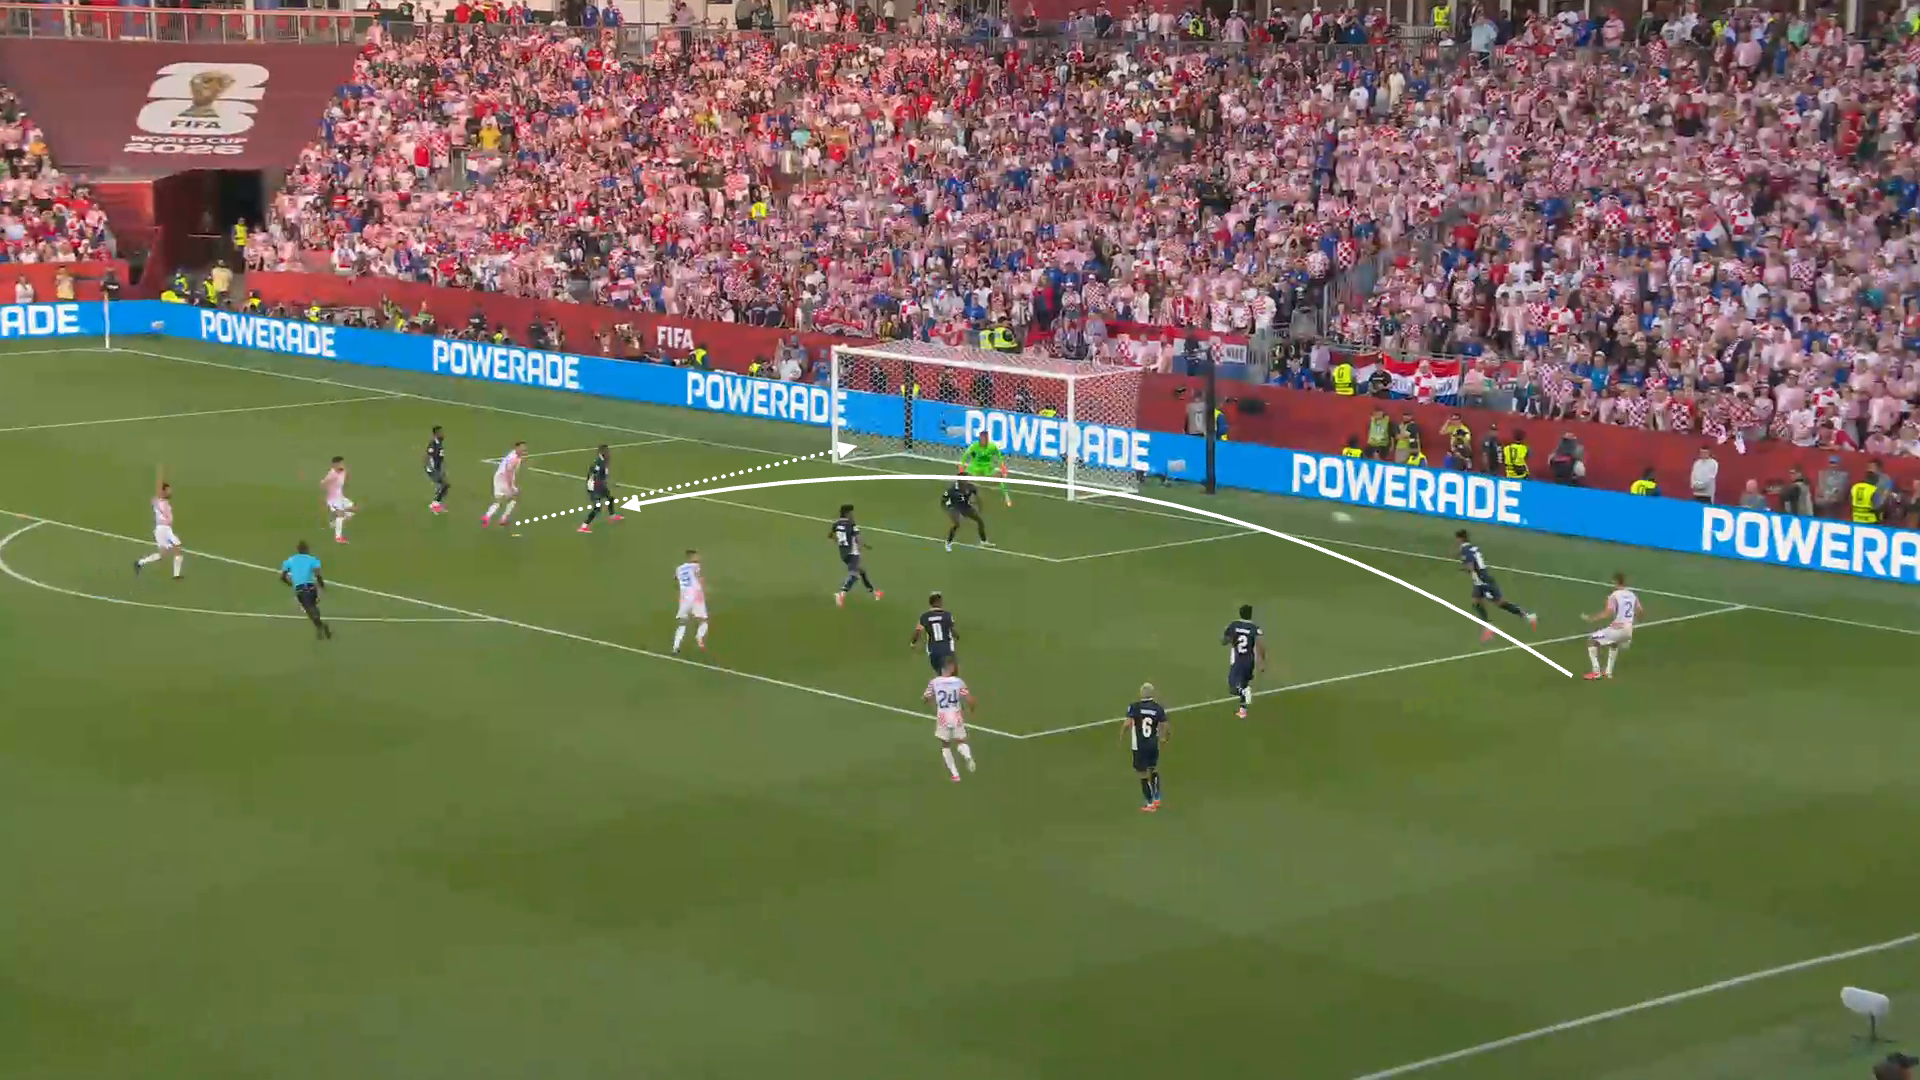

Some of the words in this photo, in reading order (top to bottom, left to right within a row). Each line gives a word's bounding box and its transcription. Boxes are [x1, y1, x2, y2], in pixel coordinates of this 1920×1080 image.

[170, 120, 221, 128] FIFA
[131, 135, 203, 143] WORLD
[1, 304, 80, 336] ADE
[200, 309, 336, 357] POWERADE
[657, 326, 694, 349] FIFA
[433, 340, 580, 389] POWERADE
[1292, 454, 1521, 524] POWERADE
[1703, 507, 1920, 582] POWERA
[1624, 602, 1632, 618] 2
[1238, 635, 1248, 653] 2
[937, 690, 958, 708] 24
[1142, 717, 1153, 738] 6
